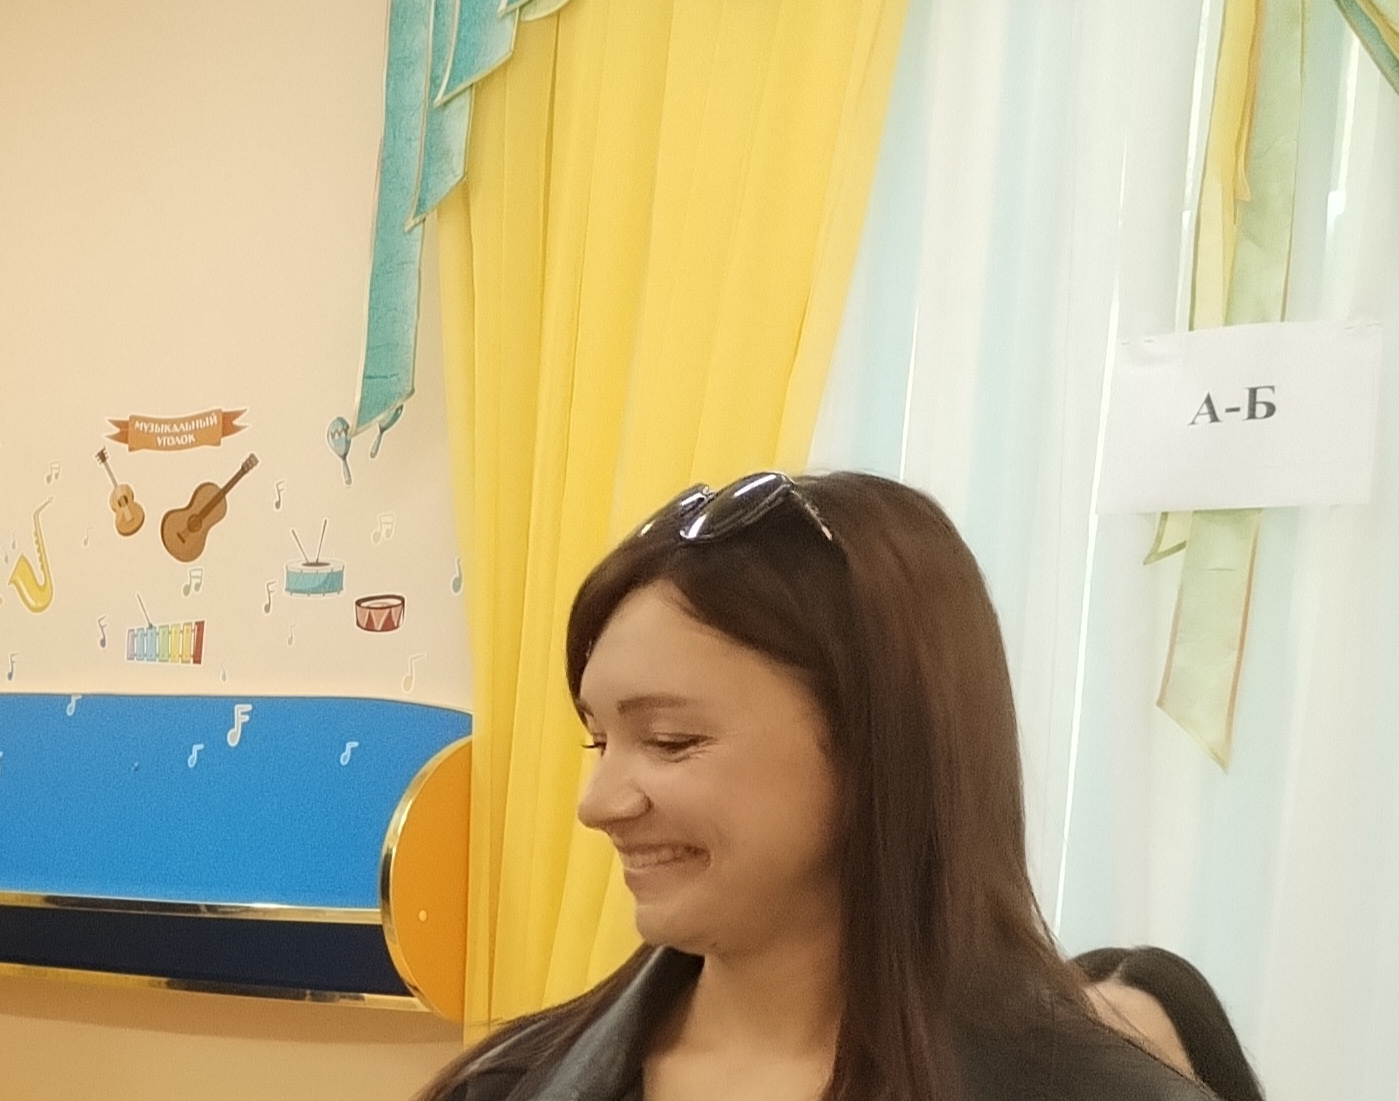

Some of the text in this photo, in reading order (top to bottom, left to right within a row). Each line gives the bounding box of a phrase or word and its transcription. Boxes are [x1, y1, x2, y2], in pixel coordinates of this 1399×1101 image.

[1187, 384, 1278, 427] А-Б
[133, 412, 218, 434] МУЗЫКАЛЬНЫЙ
[156, 433, 196, 447] УГОЛОК
